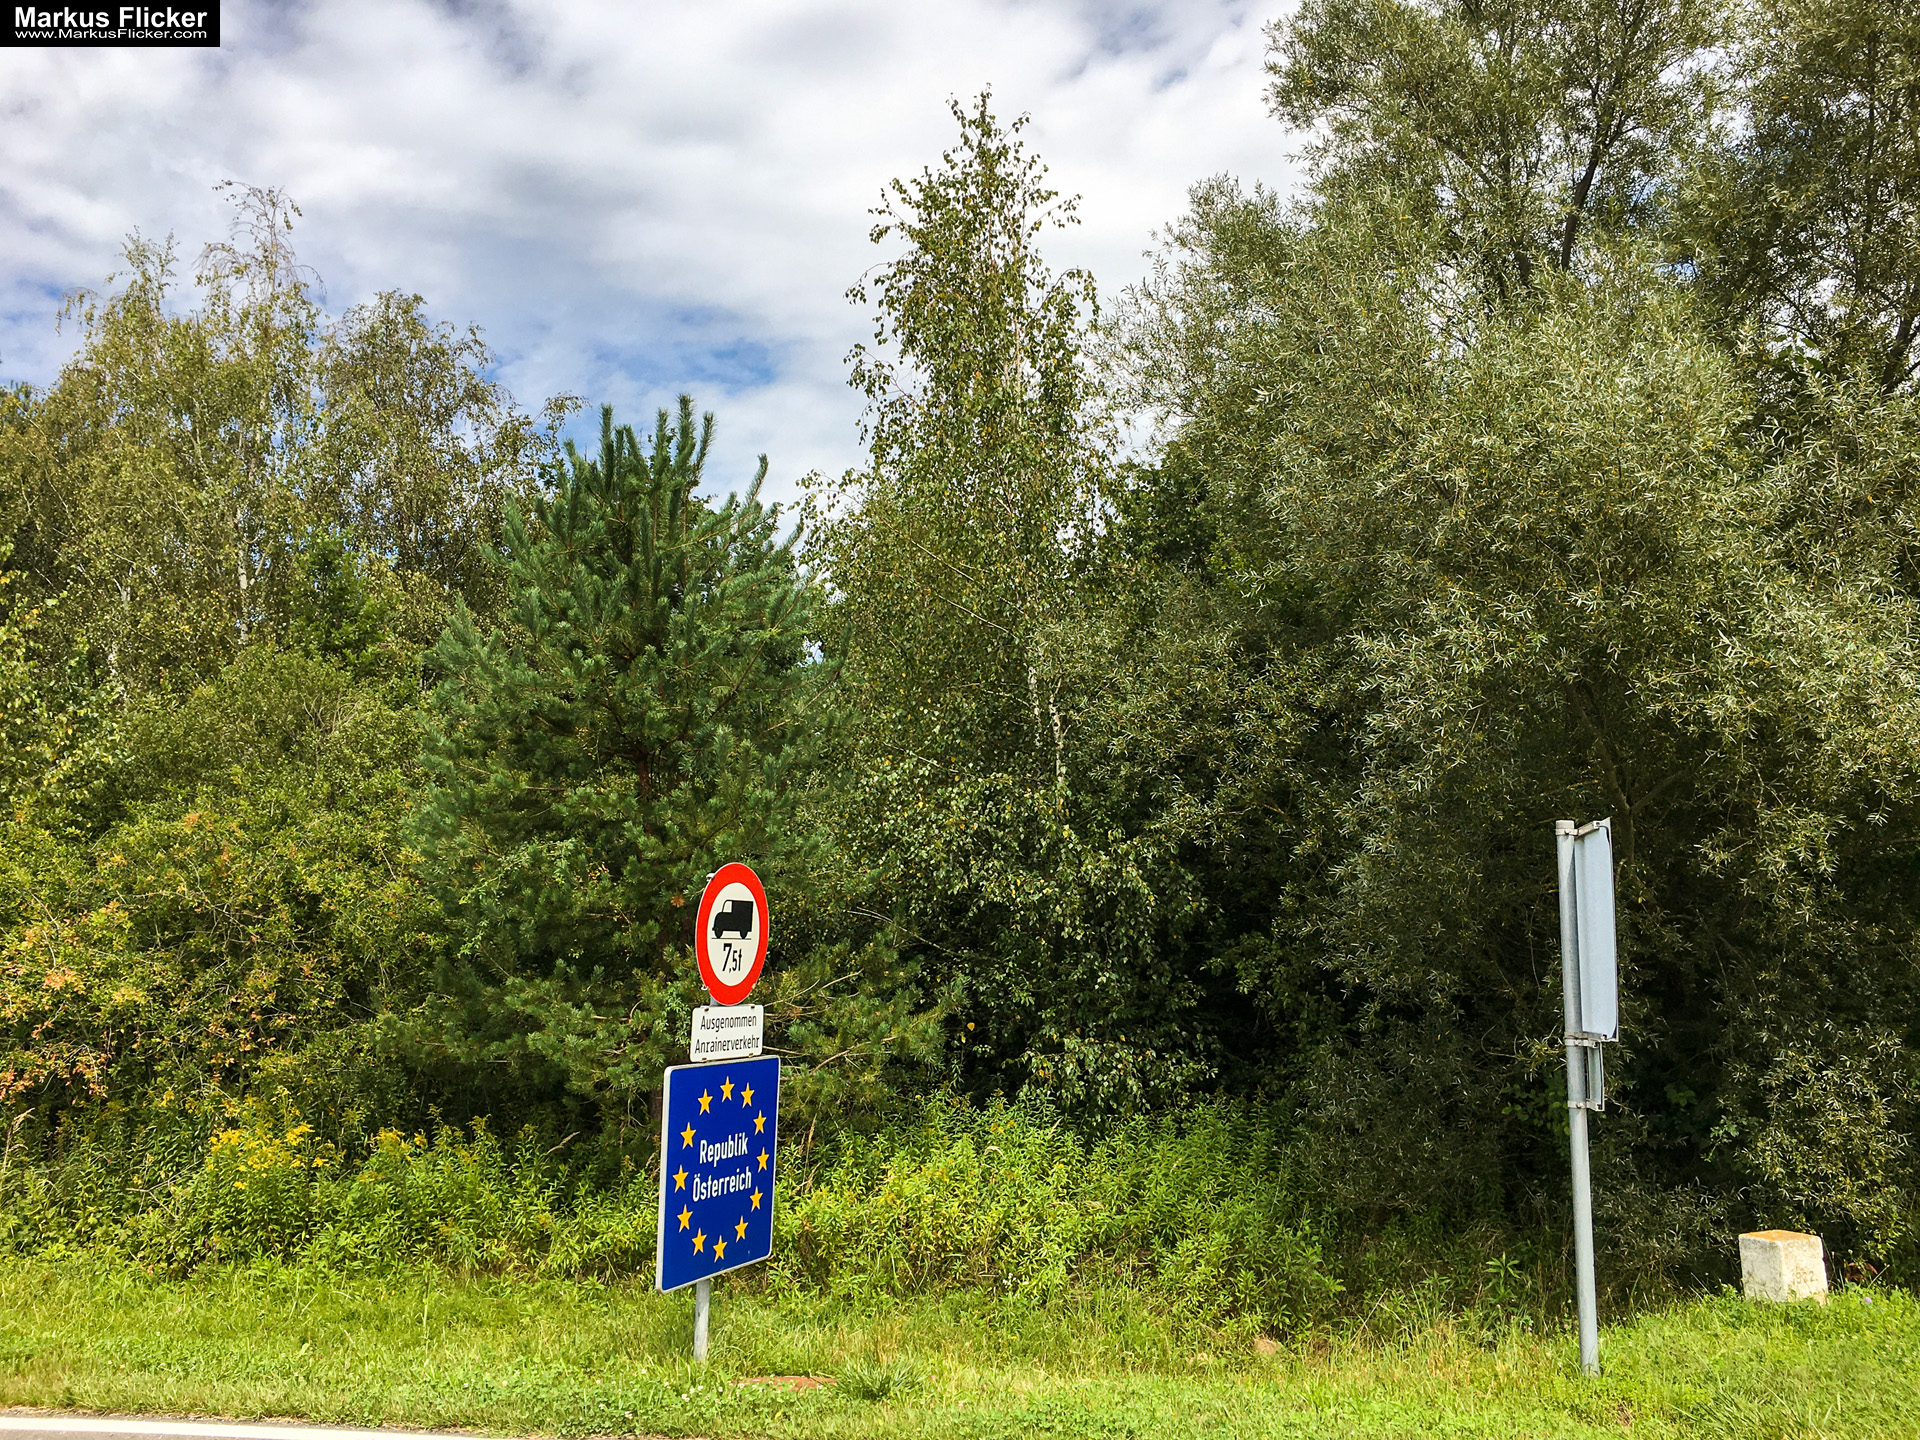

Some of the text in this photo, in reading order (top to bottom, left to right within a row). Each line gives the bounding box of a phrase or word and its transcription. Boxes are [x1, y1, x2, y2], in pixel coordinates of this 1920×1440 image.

[722, 943, 742, 973] 7,5t
[700, 1015, 757, 1033] Ausgenommen
[694, 1034, 760, 1054] Anrainerverkehr
[699, 1132, 749, 1168] Republik
[692, 1166, 752, 1203] Österreich
